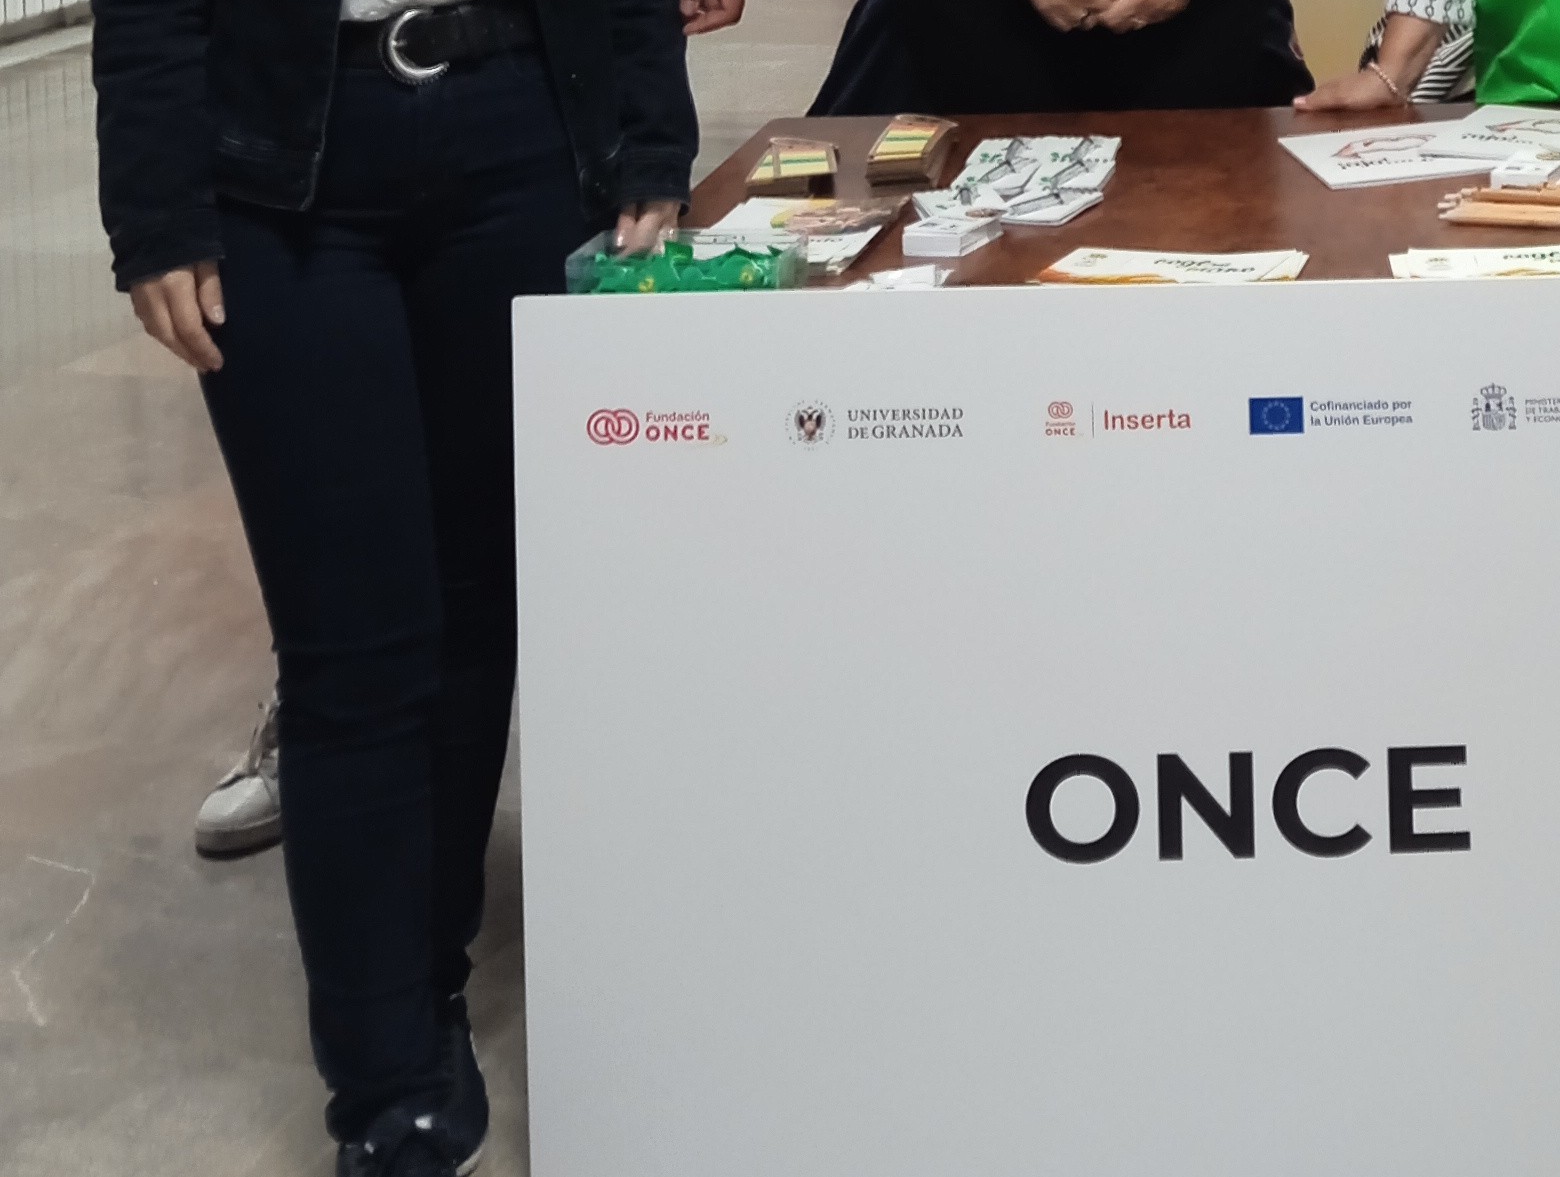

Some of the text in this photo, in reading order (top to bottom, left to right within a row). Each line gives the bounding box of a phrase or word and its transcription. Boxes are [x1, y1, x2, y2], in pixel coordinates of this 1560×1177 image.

[1310, 400, 1412, 413] Cofinanciado por
[646, 410, 710, 423] Fundación
[847, 407, 964, 422] UNIVERSIDAD
[1103, 408, 1191, 431] Inserta
[1310, 413, 1414, 427] la Unión Europea
[646, 424, 710, 441] ONCE
[847, 423, 964, 440] DE GRANADA
[1045, 428, 1076, 437] ONCE
[1024, 743, 1472, 866] ONCE
